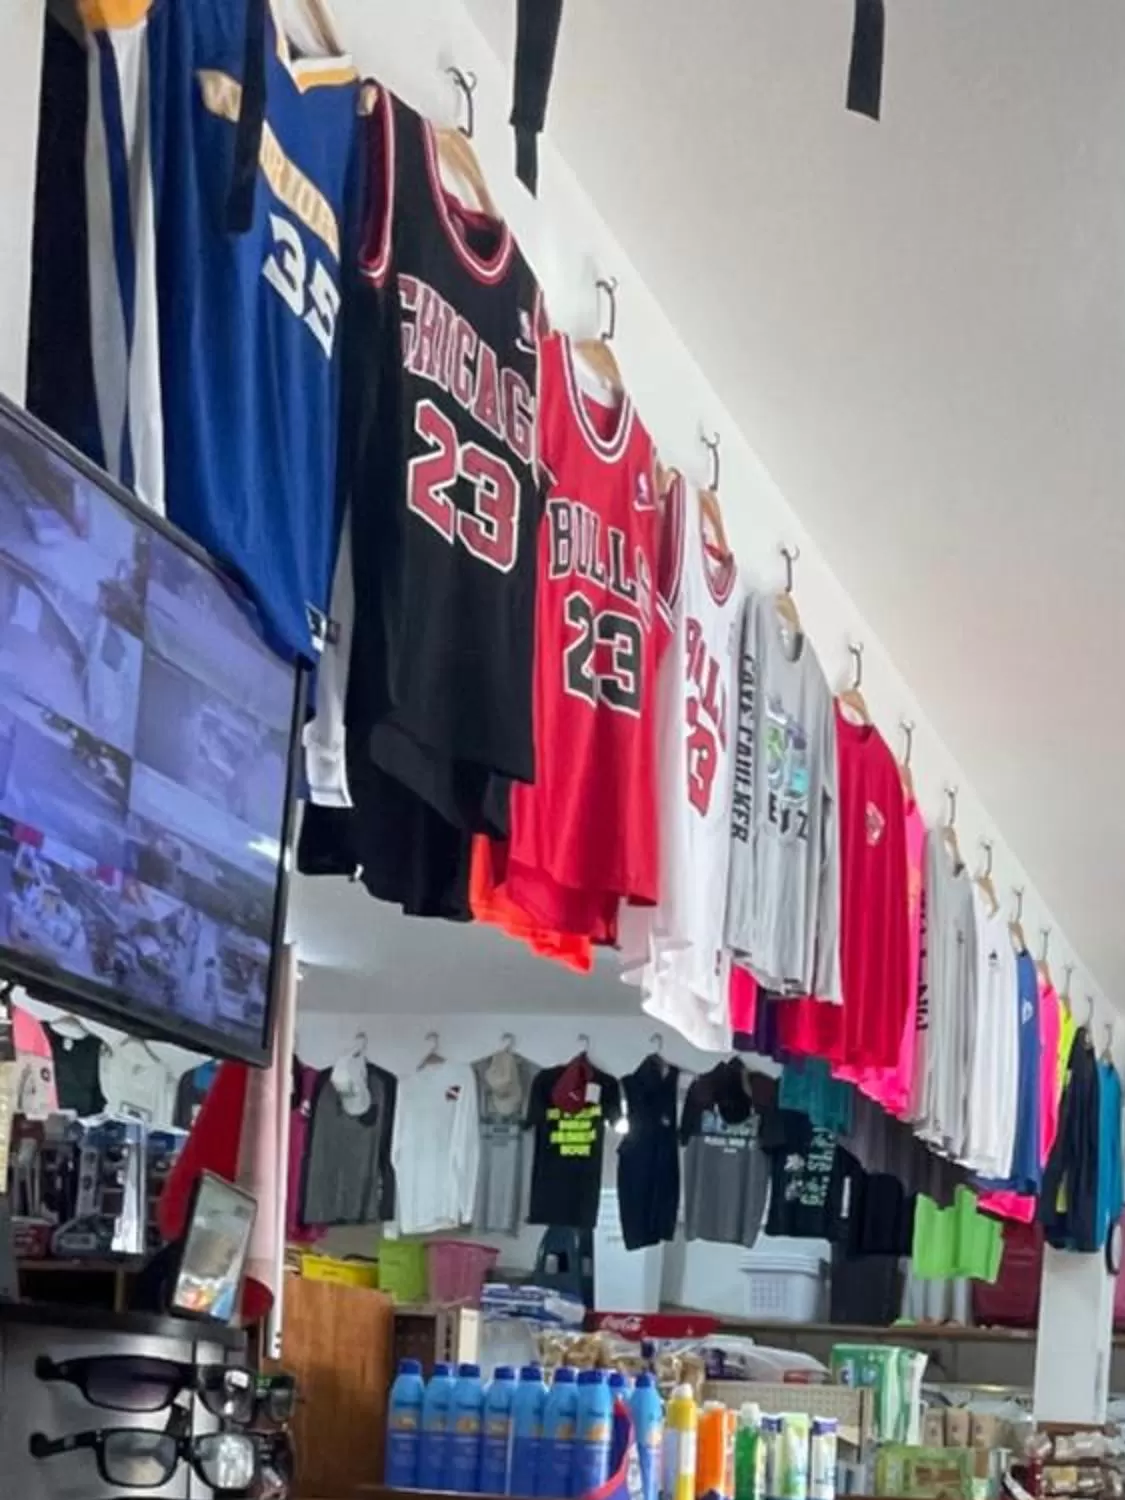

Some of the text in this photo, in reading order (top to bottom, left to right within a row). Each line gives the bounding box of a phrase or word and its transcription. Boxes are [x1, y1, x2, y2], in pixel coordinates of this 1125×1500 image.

[262, 212, 341, 359] 35
[397, 273, 536, 464] CHICAG
[406, 400, 520, 574] 23
[563, 591, 643, 714] 23
